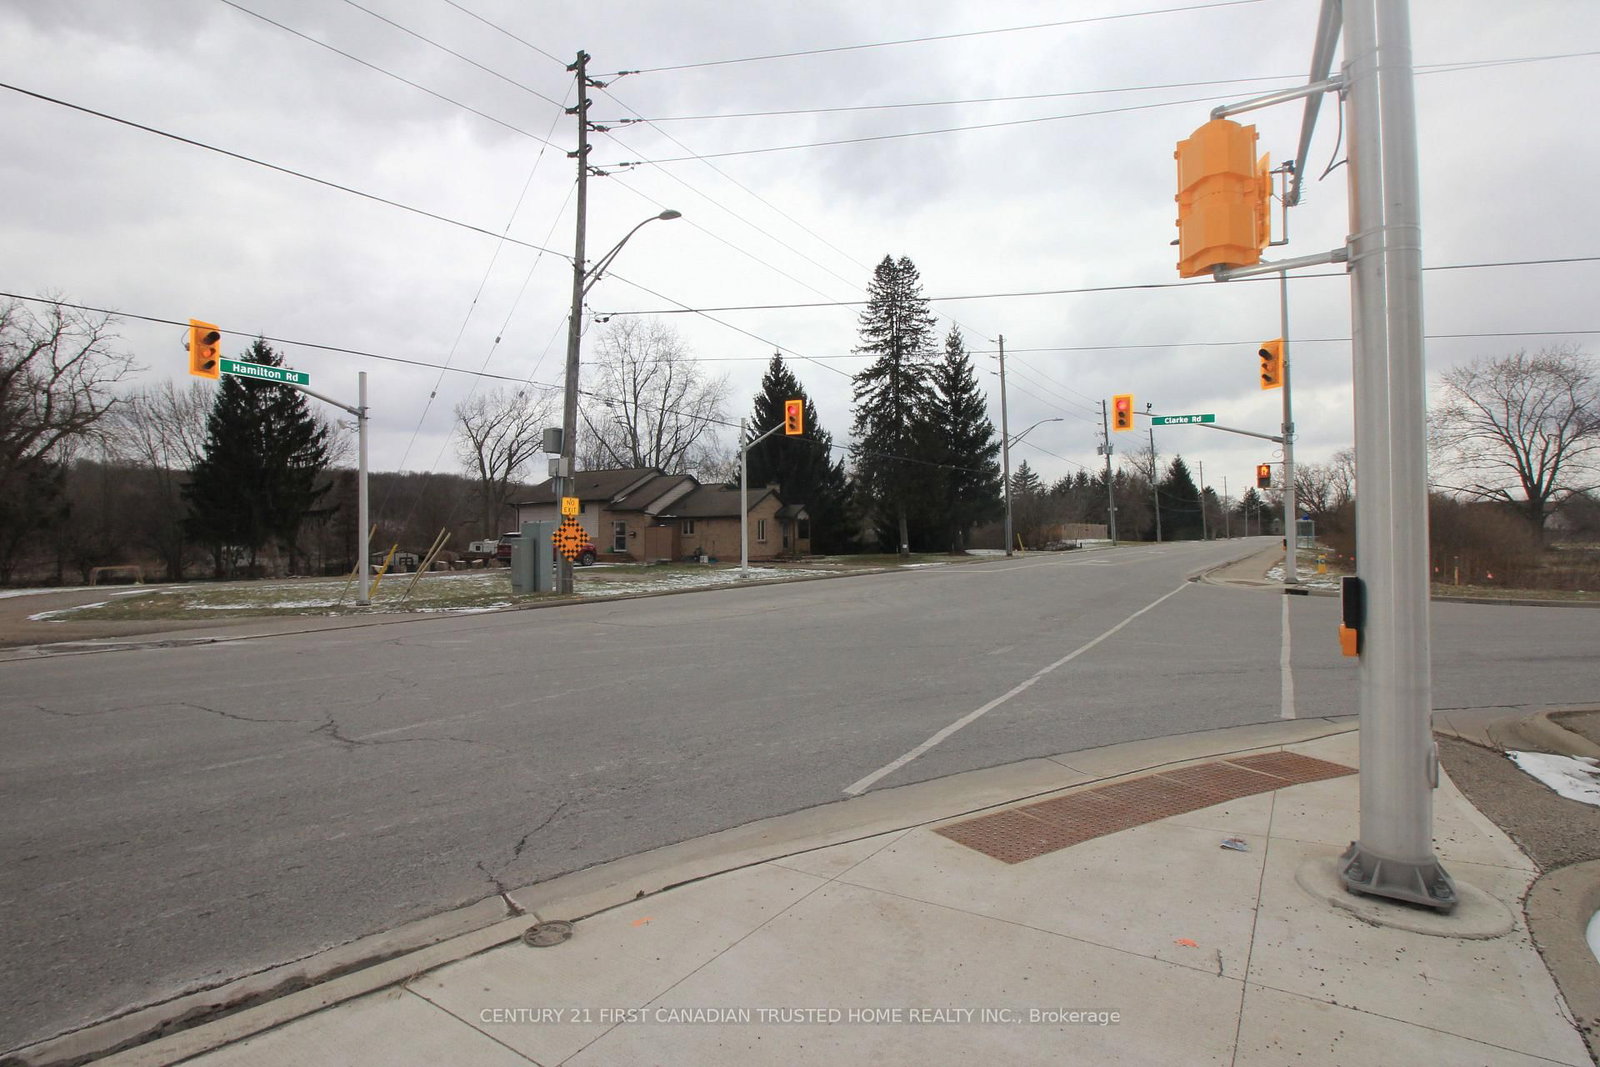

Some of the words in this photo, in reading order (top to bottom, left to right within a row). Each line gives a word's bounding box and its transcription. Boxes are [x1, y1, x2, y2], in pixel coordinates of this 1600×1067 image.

[232, 363, 281, 379] Hamilton
[286, 372, 299, 382] Rd
[1164, 416, 1189, 424] Clarke
[1191, 415, 1202, 423] Rd
